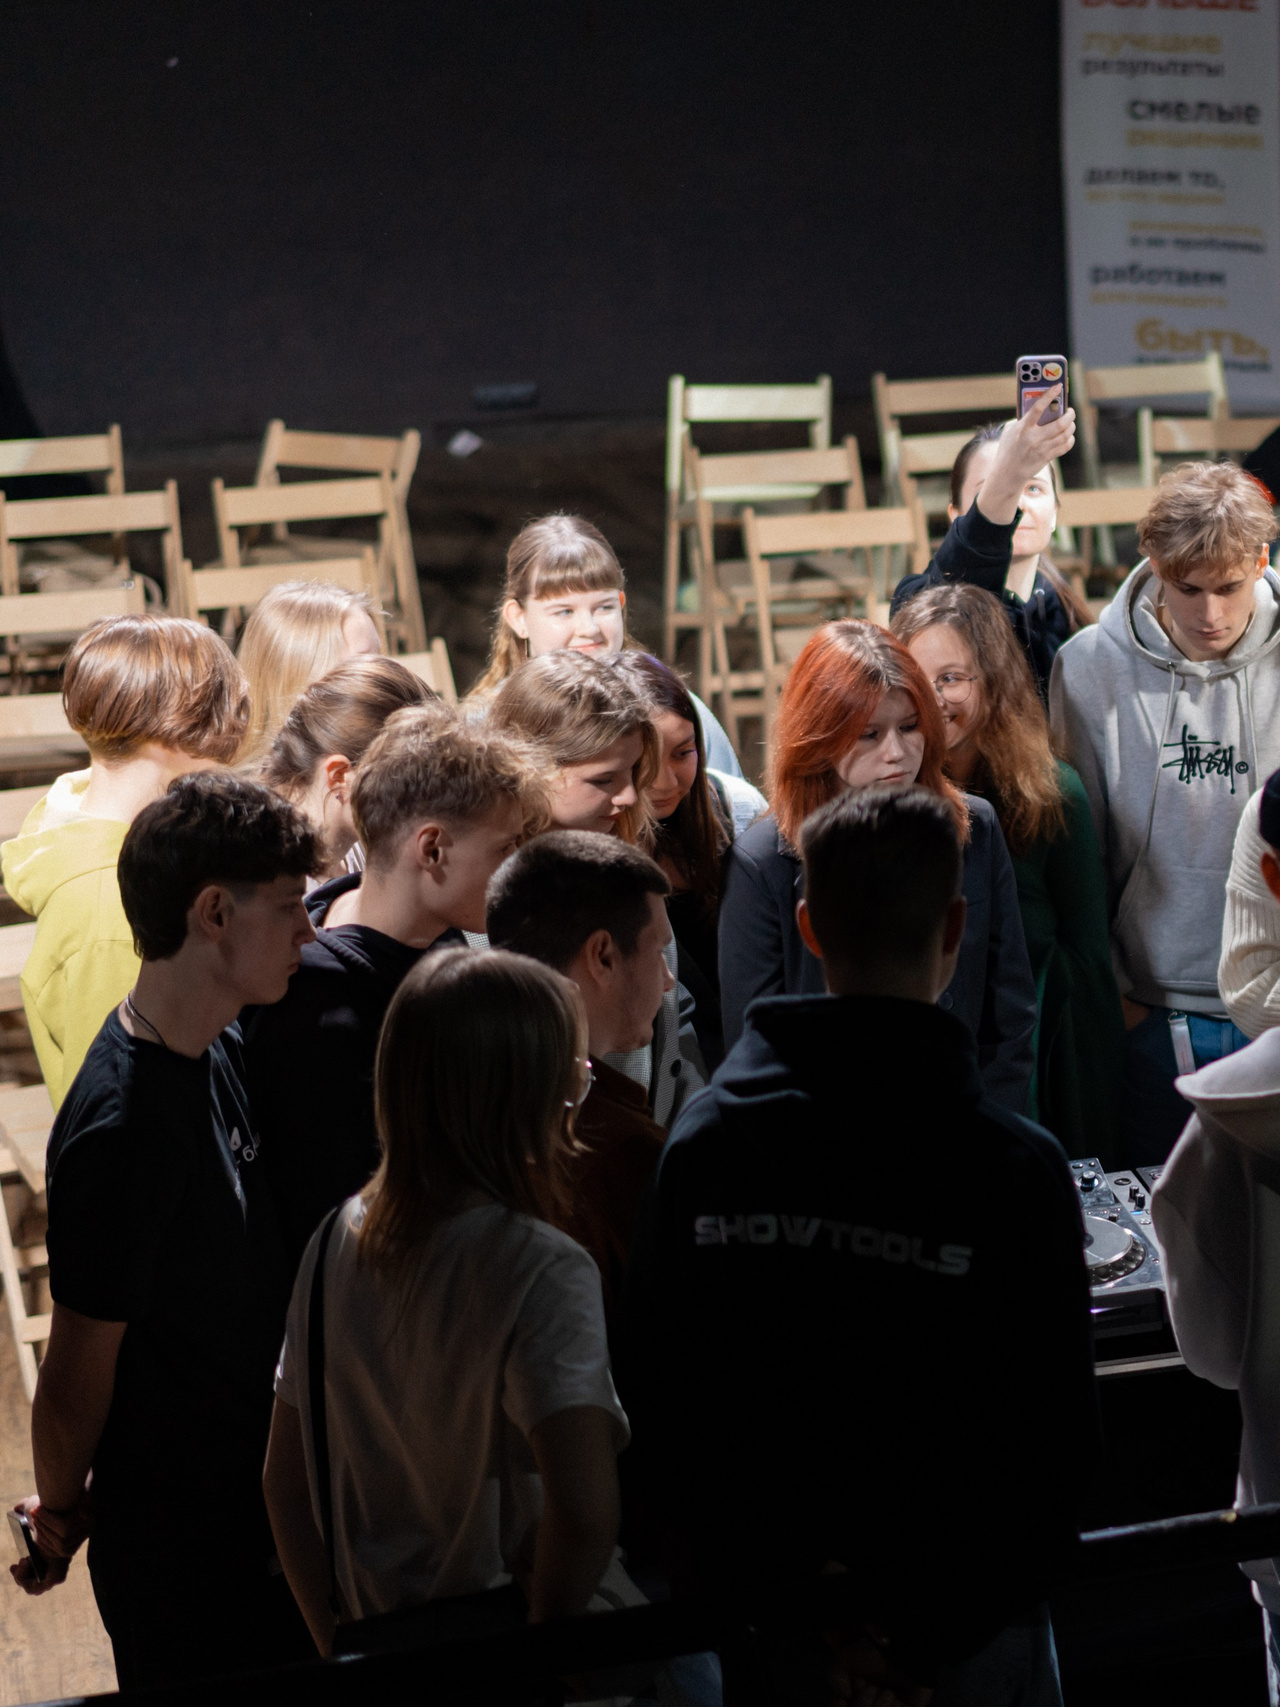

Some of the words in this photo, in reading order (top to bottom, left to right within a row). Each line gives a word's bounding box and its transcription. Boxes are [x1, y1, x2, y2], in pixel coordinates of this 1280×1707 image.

[1128, 99, 1261, 125] смелые
[1090, 262, 1226, 287] работаем
[694, 1212, 974, 1277] SHOWTOOLS
